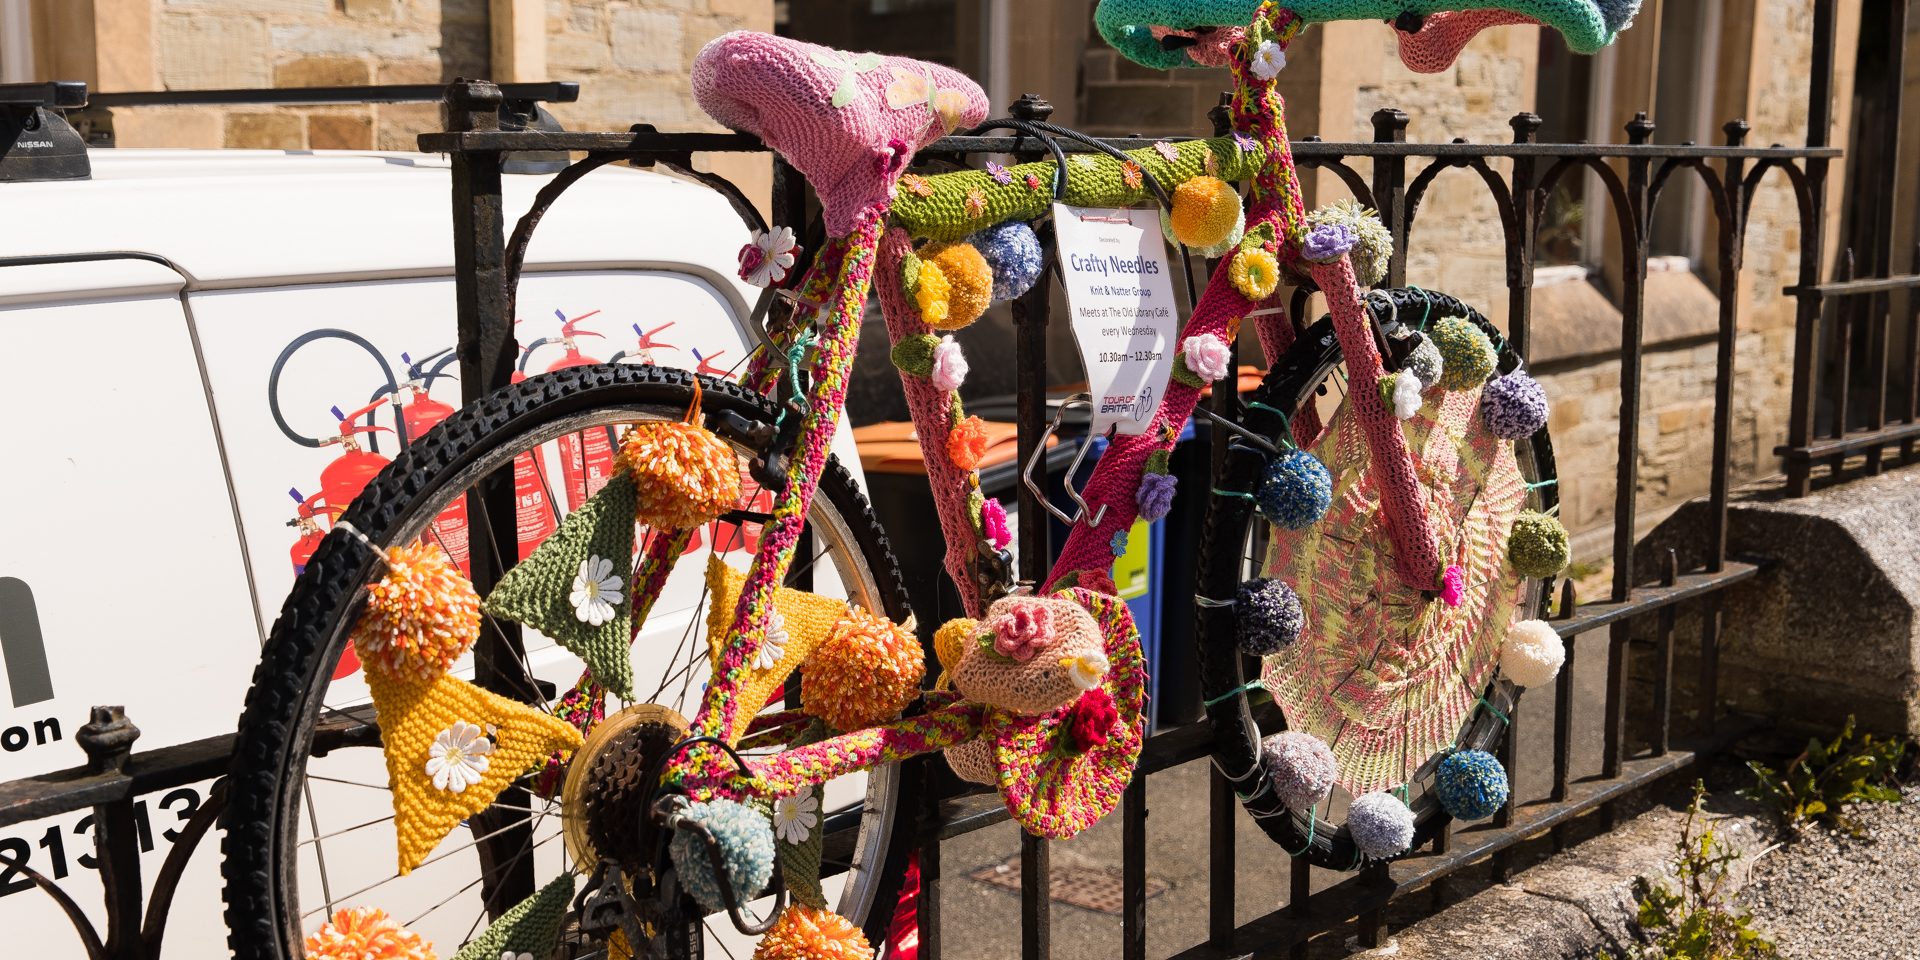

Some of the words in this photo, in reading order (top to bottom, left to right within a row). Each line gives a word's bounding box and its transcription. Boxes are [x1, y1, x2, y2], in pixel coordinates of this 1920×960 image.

[1070, 253, 1108, 277] Crafty
[1109, 255, 1159, 275] Needles
[1090, 286, 1104, 296] Knit
[1104, 286, 1110, 296] &
[1111, 286, 1131, 297] Natter
[1132, 287, 1151, 298] Group
[1079, 307, 1100, 318] Meets
[1101, 309, 1108, 318] at
[1109, 307, 1121, 318] The
[1122, 306, 1133, 318] Old
[1134, 307, 1155, 319] Library
[1155, 307, 1169, 318] Café
[1101, 328, 1120, 338] every
[1120, 326, 1157, 338] Wednesday
[1099, 352, 1128, 363] 10.30am
[1134, 351, 1162, 362] 12.30am
[1103, 396, 1125, 405] TOUR
[1125, 395, 1136, 404] OF
[1100, 403, 1135, 414] BRITAIN
